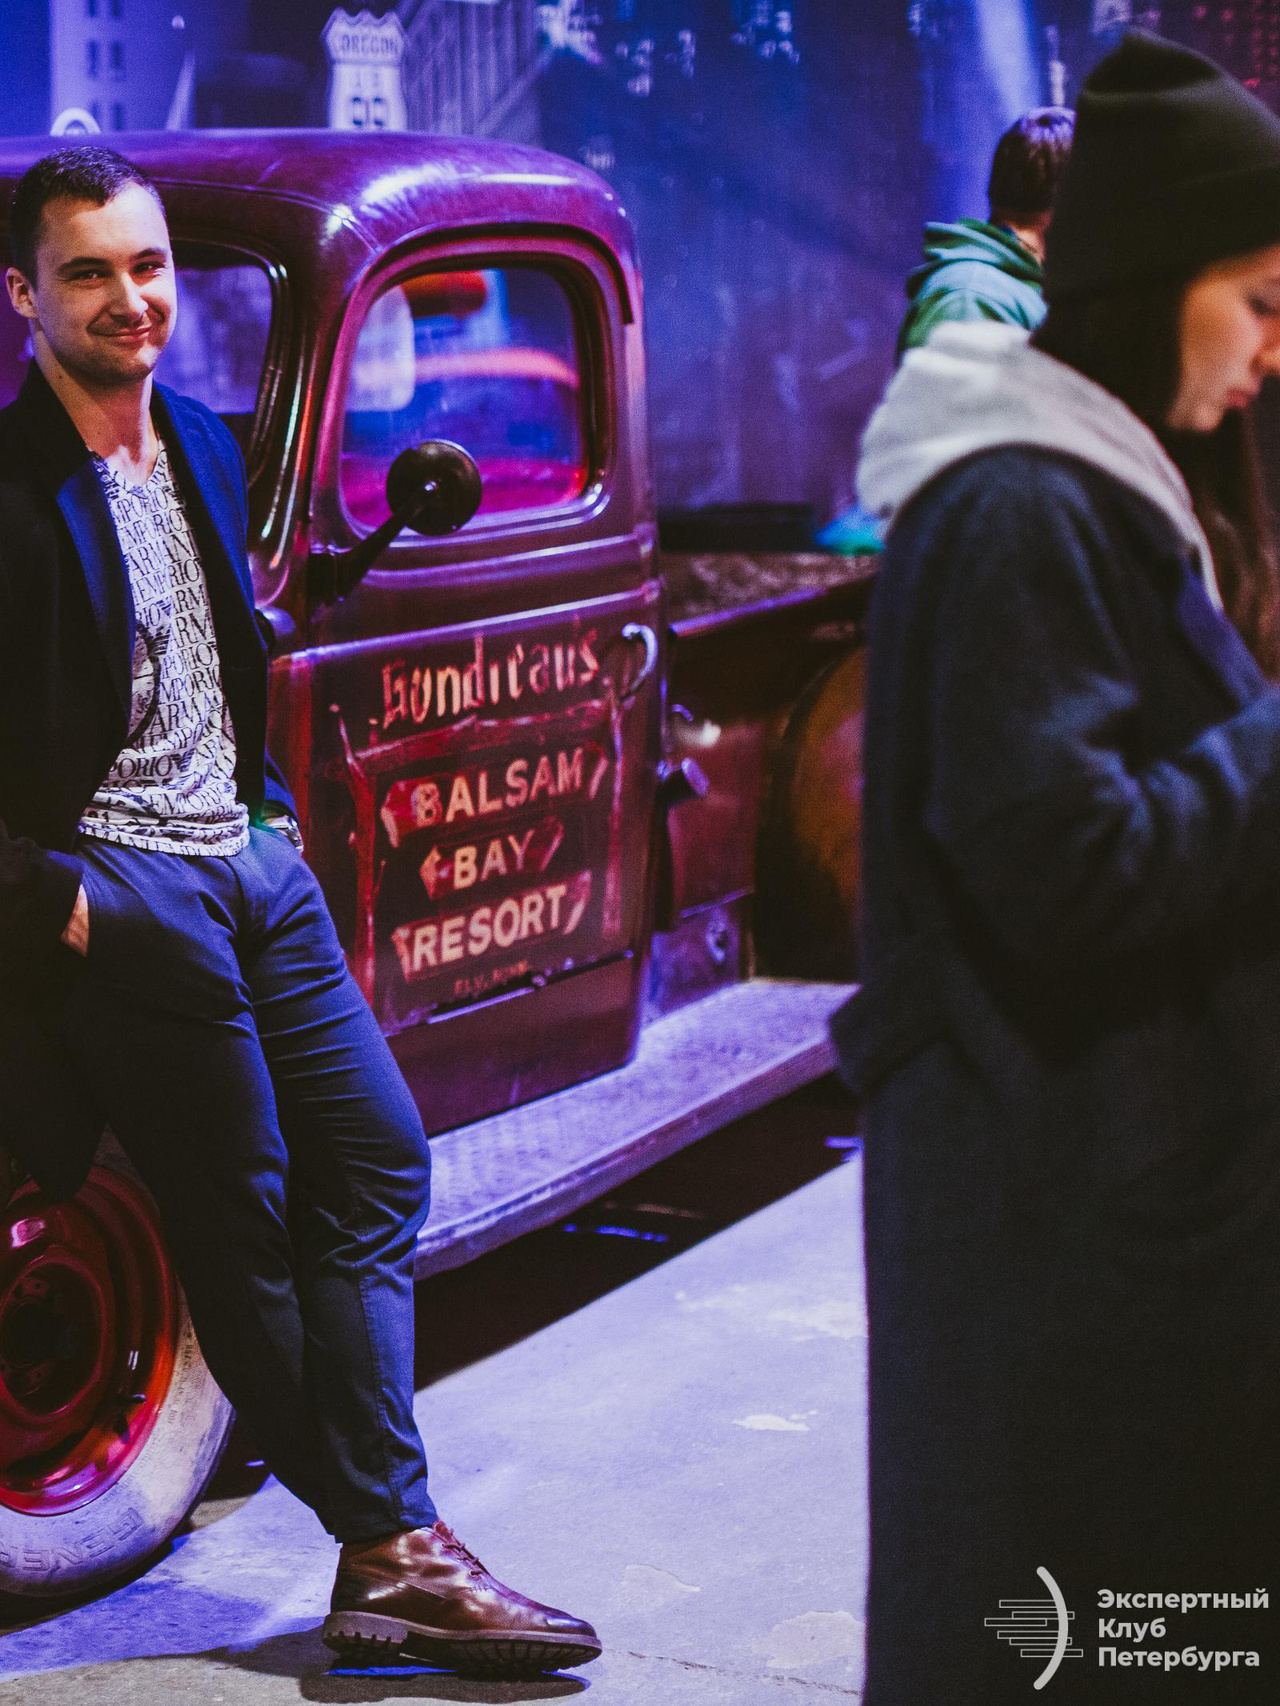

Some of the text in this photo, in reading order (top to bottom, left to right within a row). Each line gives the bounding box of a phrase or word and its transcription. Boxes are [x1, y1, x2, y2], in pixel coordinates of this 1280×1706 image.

[341, 34, 399, 56] OREGON
[411, 747, 584, 829] BALSAM
[453, 829, 535, 891] BAY
[413, 882, 568, 972] RESORT
